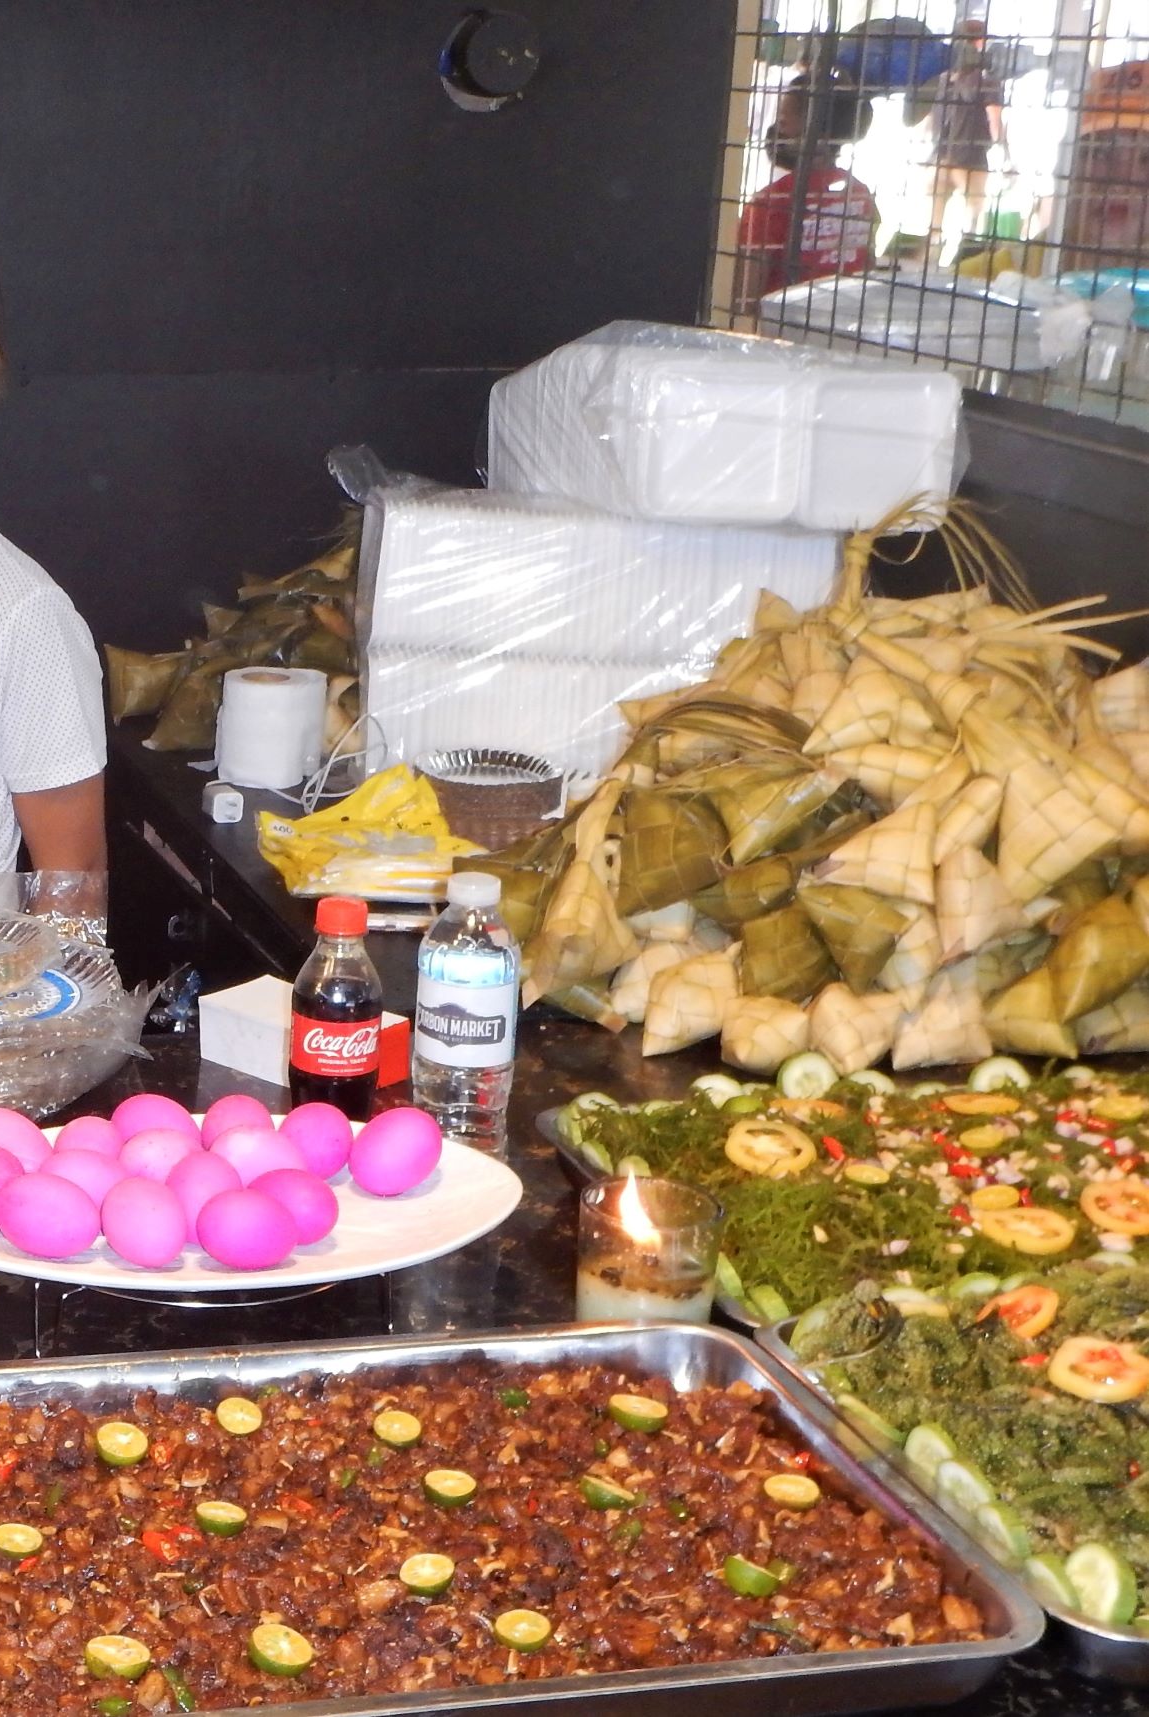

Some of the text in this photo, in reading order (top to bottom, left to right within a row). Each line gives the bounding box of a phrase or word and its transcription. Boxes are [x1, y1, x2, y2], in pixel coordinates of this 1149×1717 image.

[418, 1007, 502, 1040] CARBON MARKET
[303, 1025, 379, 1057] Coca-Cola
